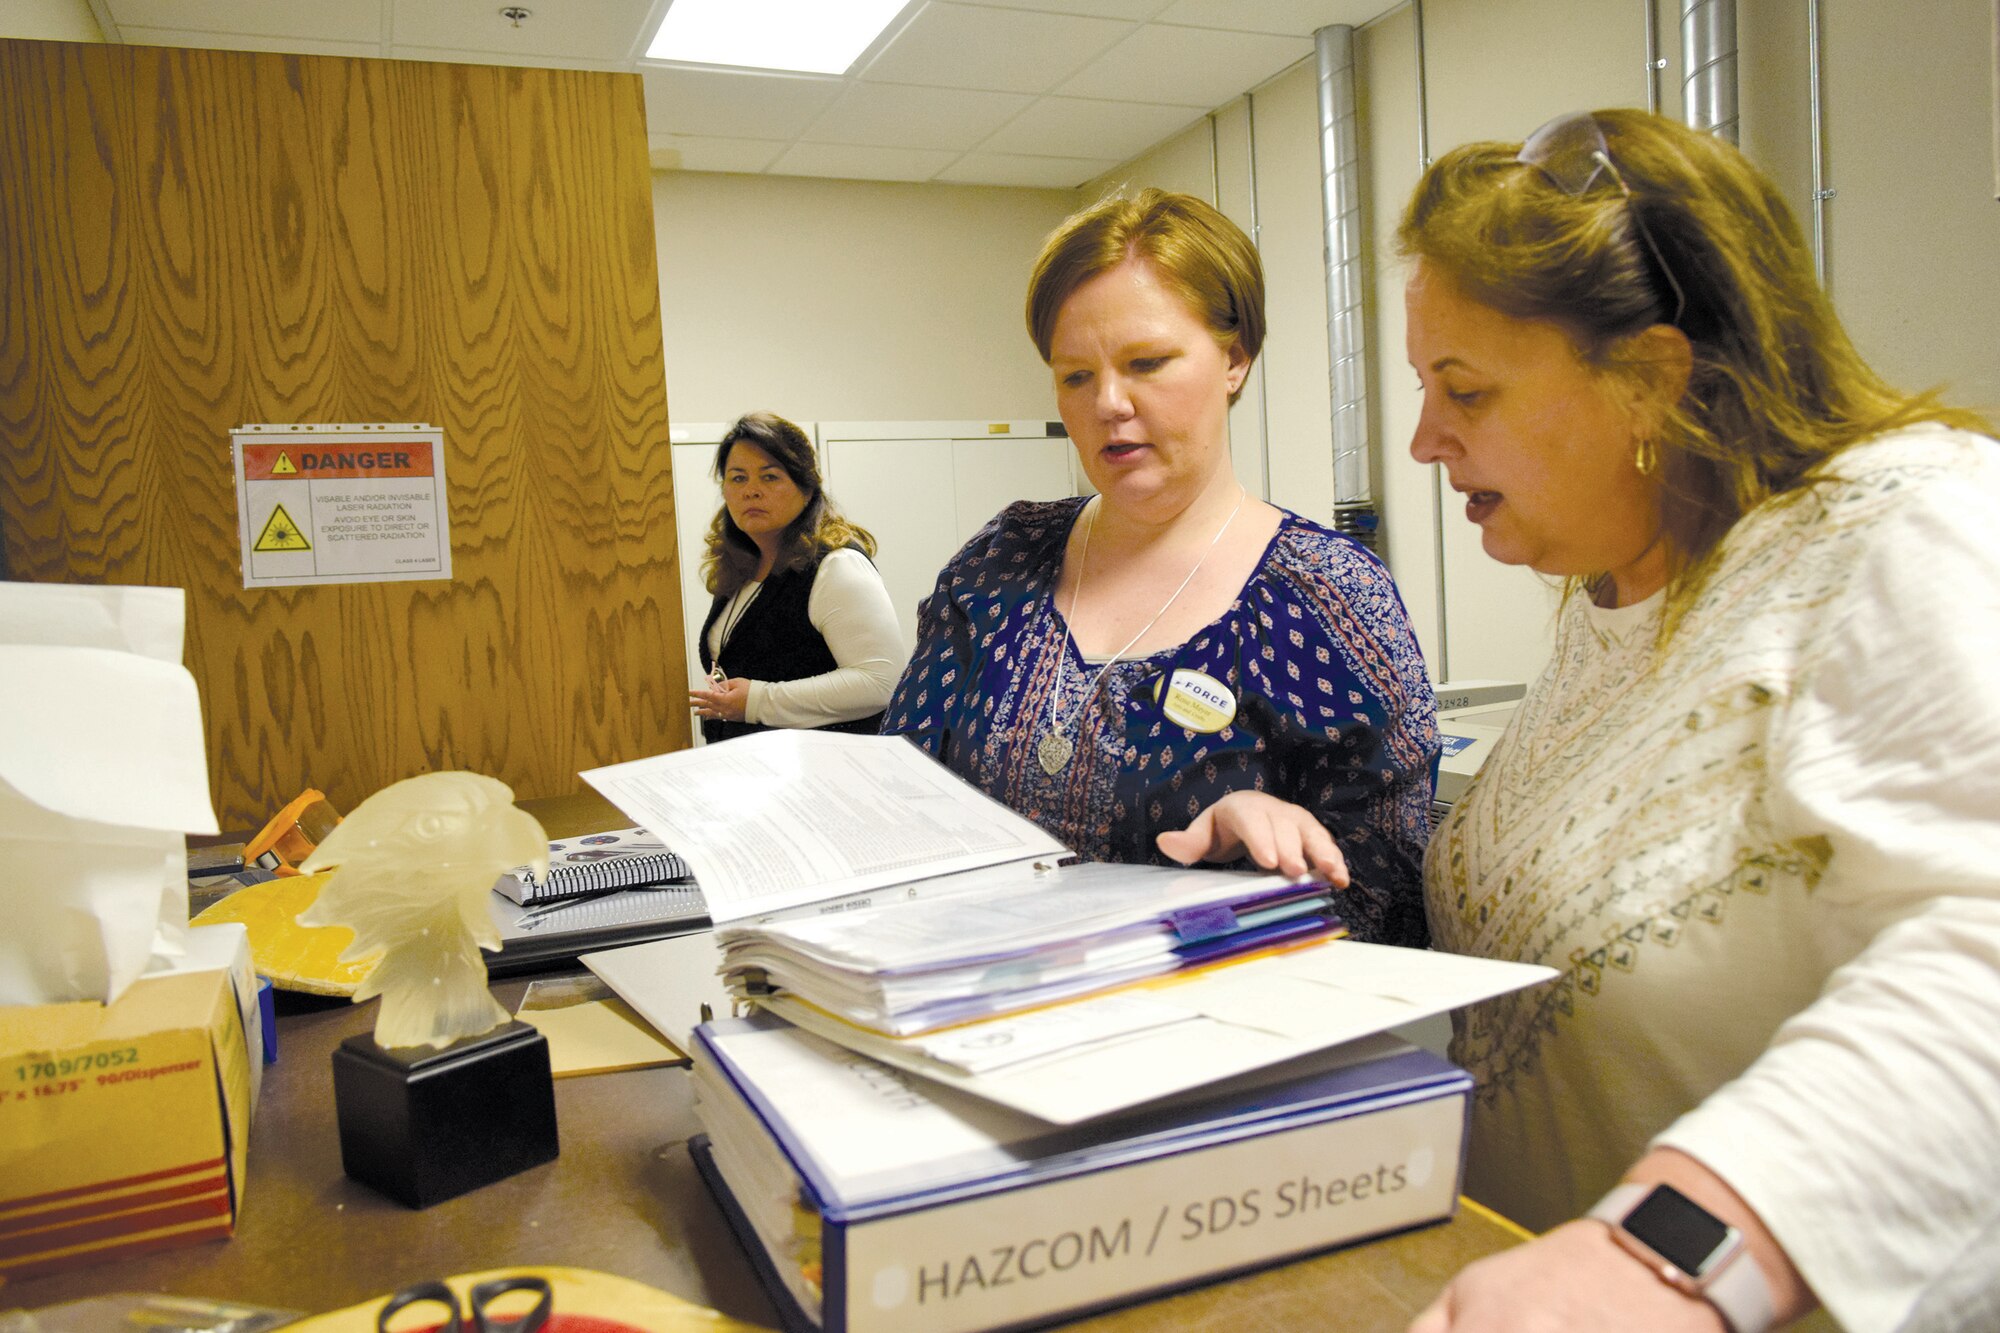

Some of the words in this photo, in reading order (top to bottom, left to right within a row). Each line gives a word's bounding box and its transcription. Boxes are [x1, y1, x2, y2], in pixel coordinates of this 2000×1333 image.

[301, 452, 410, 470] DANGER
[353, 494, 386, 502] AND/OR
[396, 514, 416, 522] SKIN
[321, 525, 368, 533] EXPOSURE
[384, 523, 414, 531] DIRECT
[327, 533, 378, 542] SCATTERED
[380, 532, 425, 540] RADIATION
[1185, 681, 1228, 709] FORCE
[17, 1048, 139, 1081] 1709/7052
[916, 1218, 1132, 1304] HAZCOM
[1144, 1206, 1169, 1257] /
[1182, 1189, 1261, 1242] SDS
[1275, 1162, 1408, 1219] Sheets
